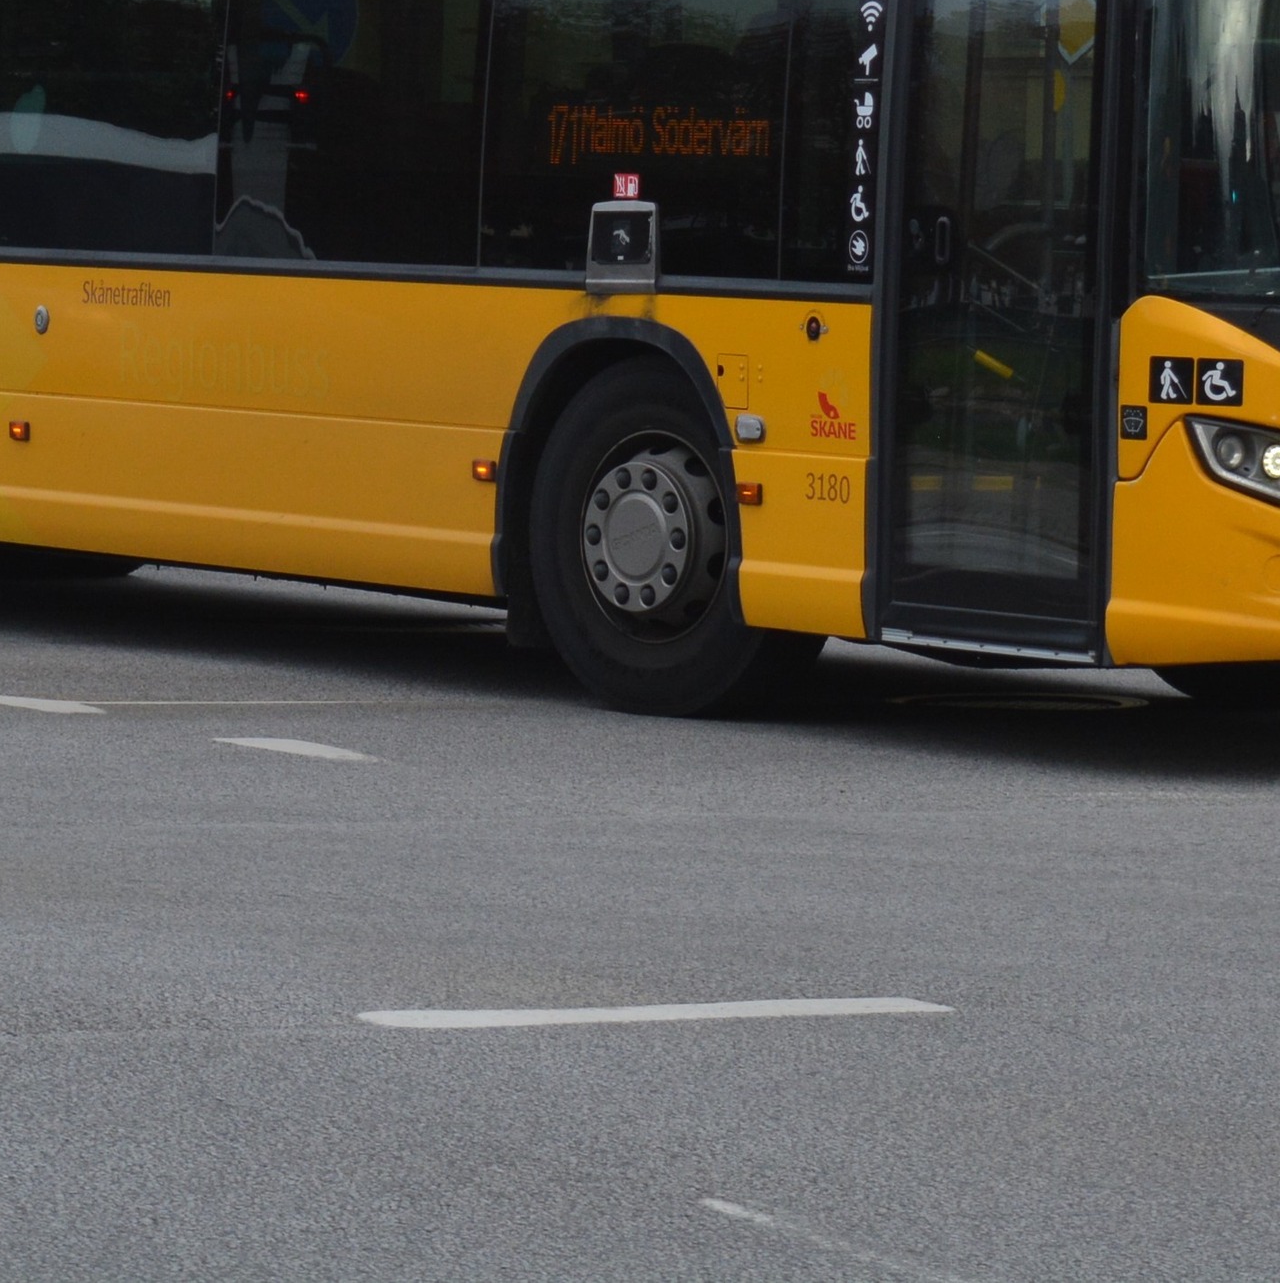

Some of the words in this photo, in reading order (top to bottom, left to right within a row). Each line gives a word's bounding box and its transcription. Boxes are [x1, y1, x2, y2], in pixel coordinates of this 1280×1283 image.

[548, 106, 577, 164] 171
[581, 106, 645, 154] Malmö
[652, 106, 769, 157] Södervärn
[82, 279, 171, 307] Skånetrafiken
[805, 472, 850, 504] 3180
